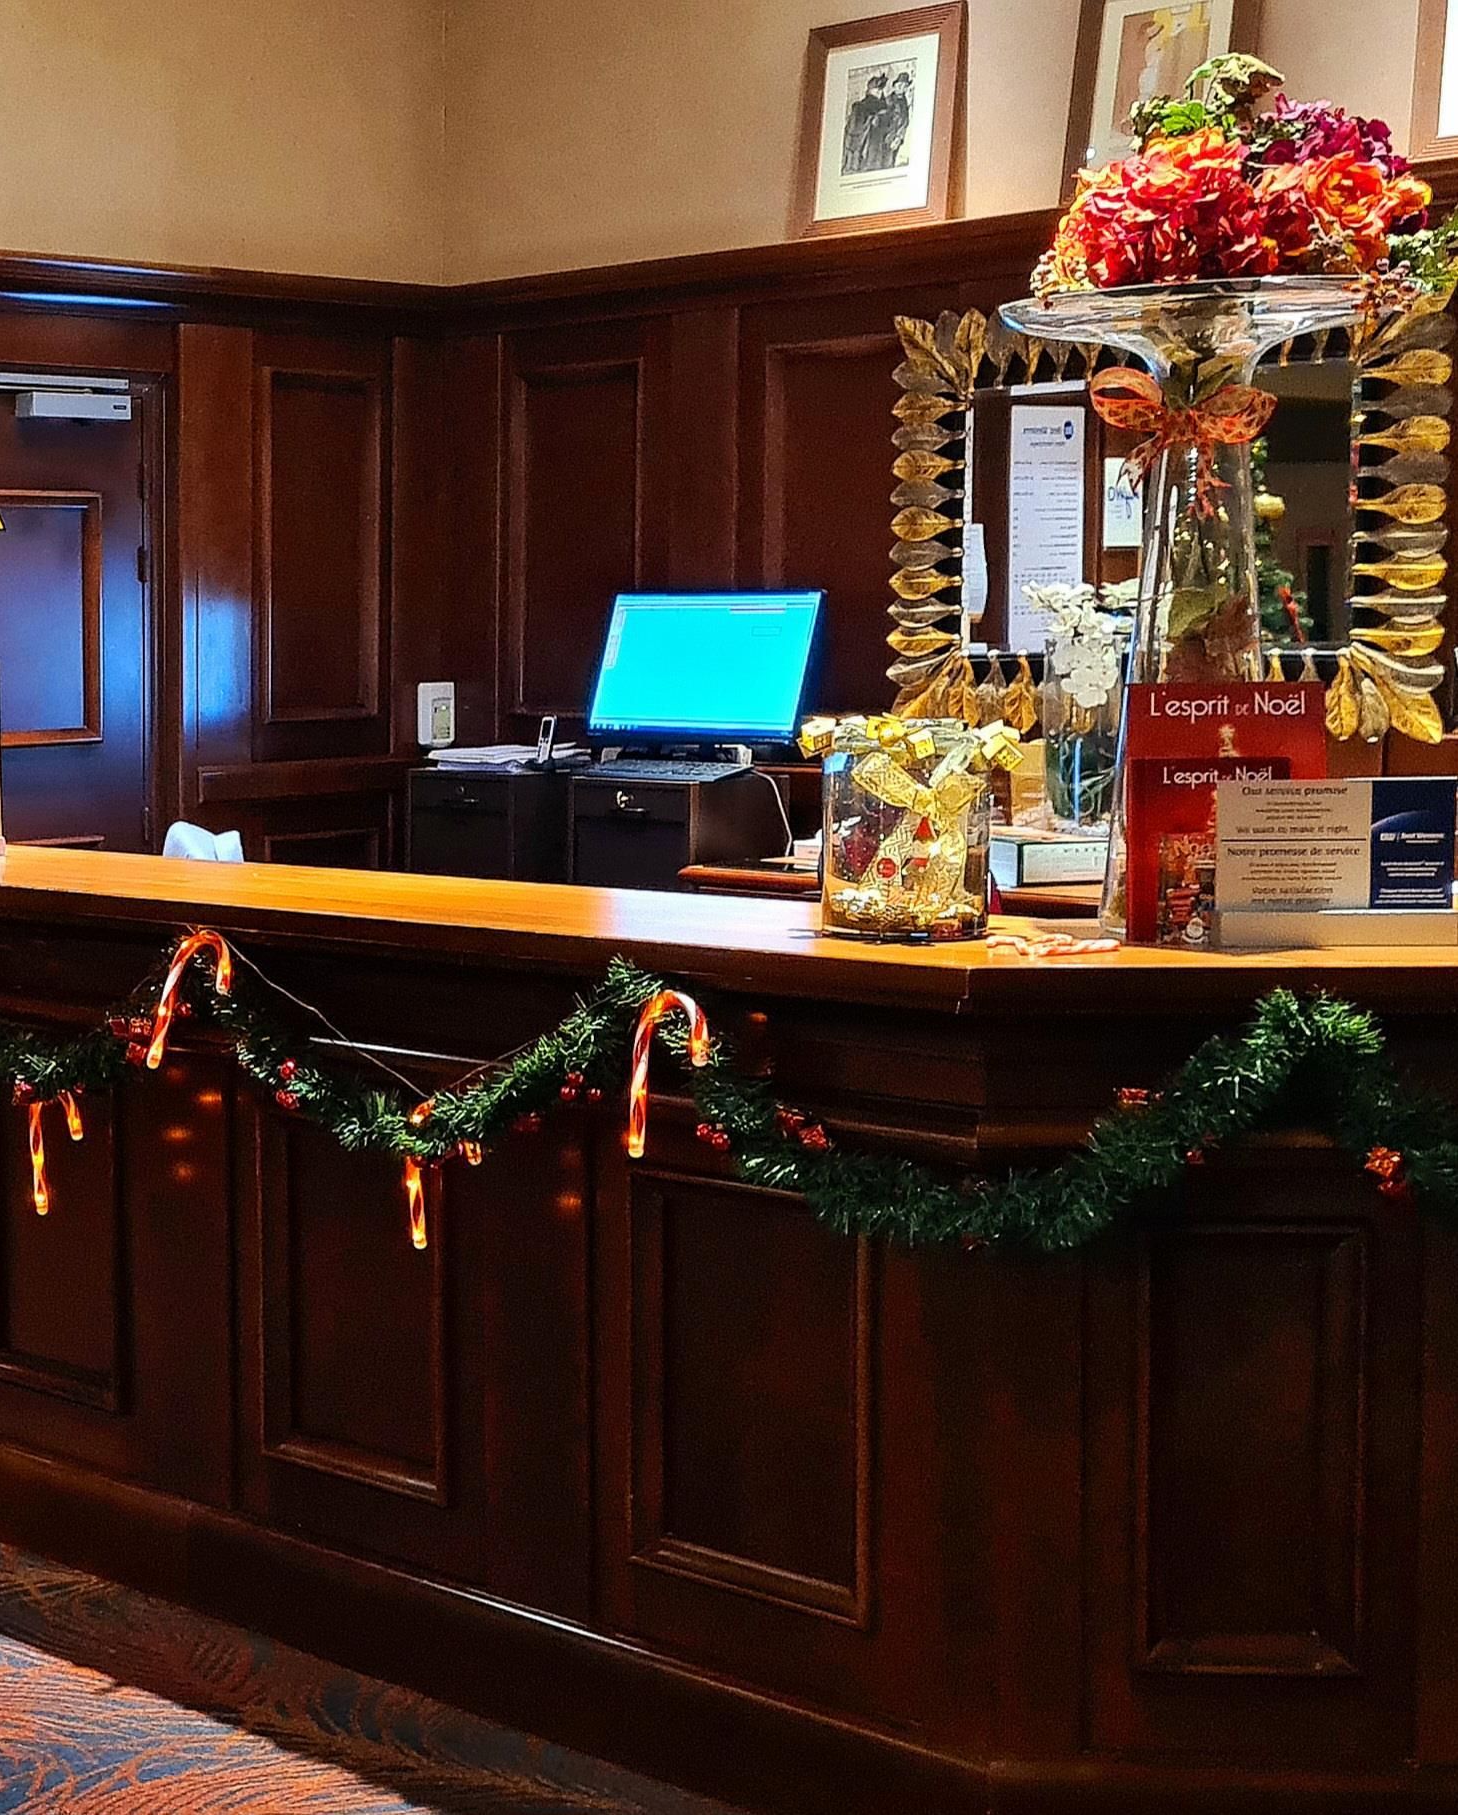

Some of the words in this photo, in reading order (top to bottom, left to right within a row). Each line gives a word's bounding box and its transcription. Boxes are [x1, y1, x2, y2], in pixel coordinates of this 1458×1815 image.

[1150, 691, 1230, 724] L'esprit
[1254, 690, 1305, 715] Noël
[1163, 766, 1219, 790] L'esprit
[1235, 765, 1272, 781] Noël
